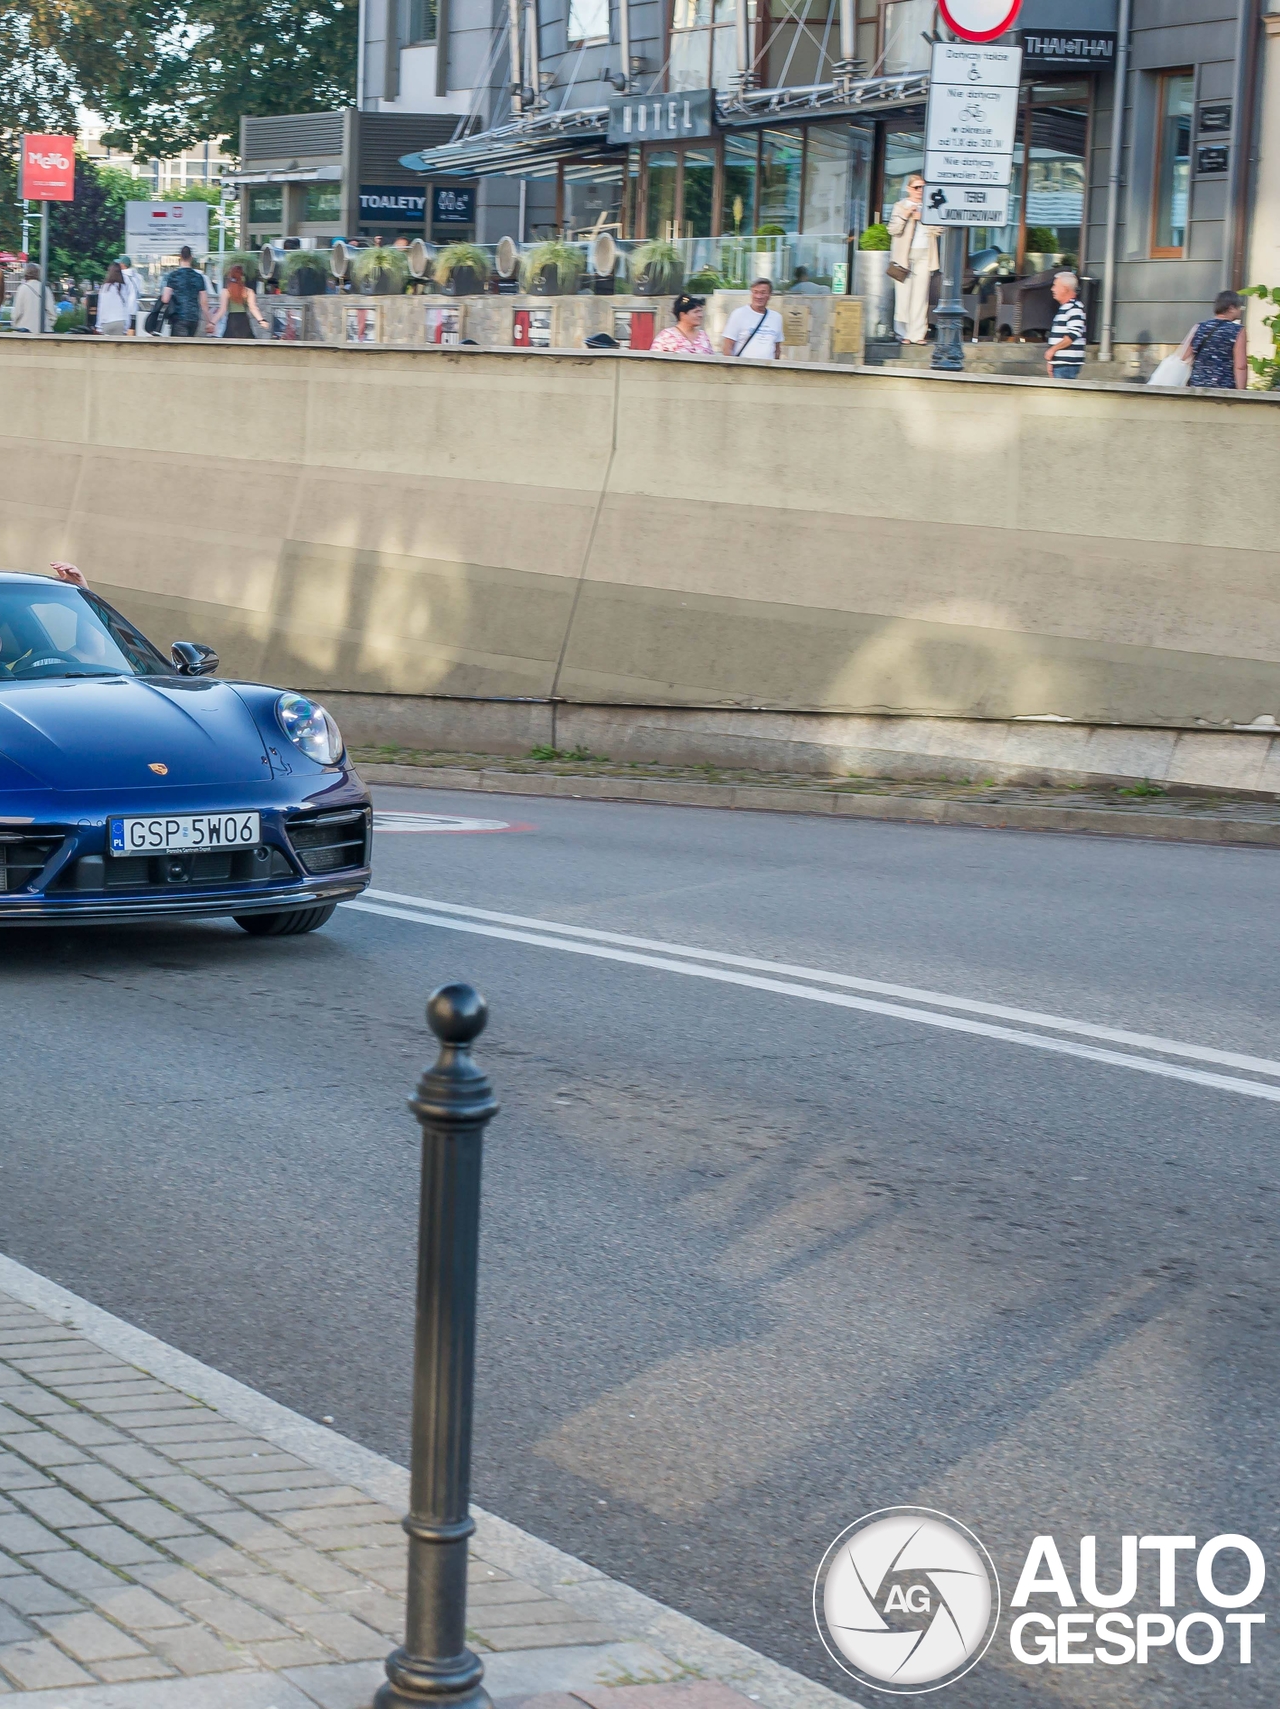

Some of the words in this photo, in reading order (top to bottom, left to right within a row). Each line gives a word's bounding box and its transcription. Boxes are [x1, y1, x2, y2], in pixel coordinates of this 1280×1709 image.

[622, 100, 693, 134] HOTEL
[359, 195, 427, 210] TOALETY
[130, 819, 180, 848] GSP
[192, 815, 253, 845] 5W06
